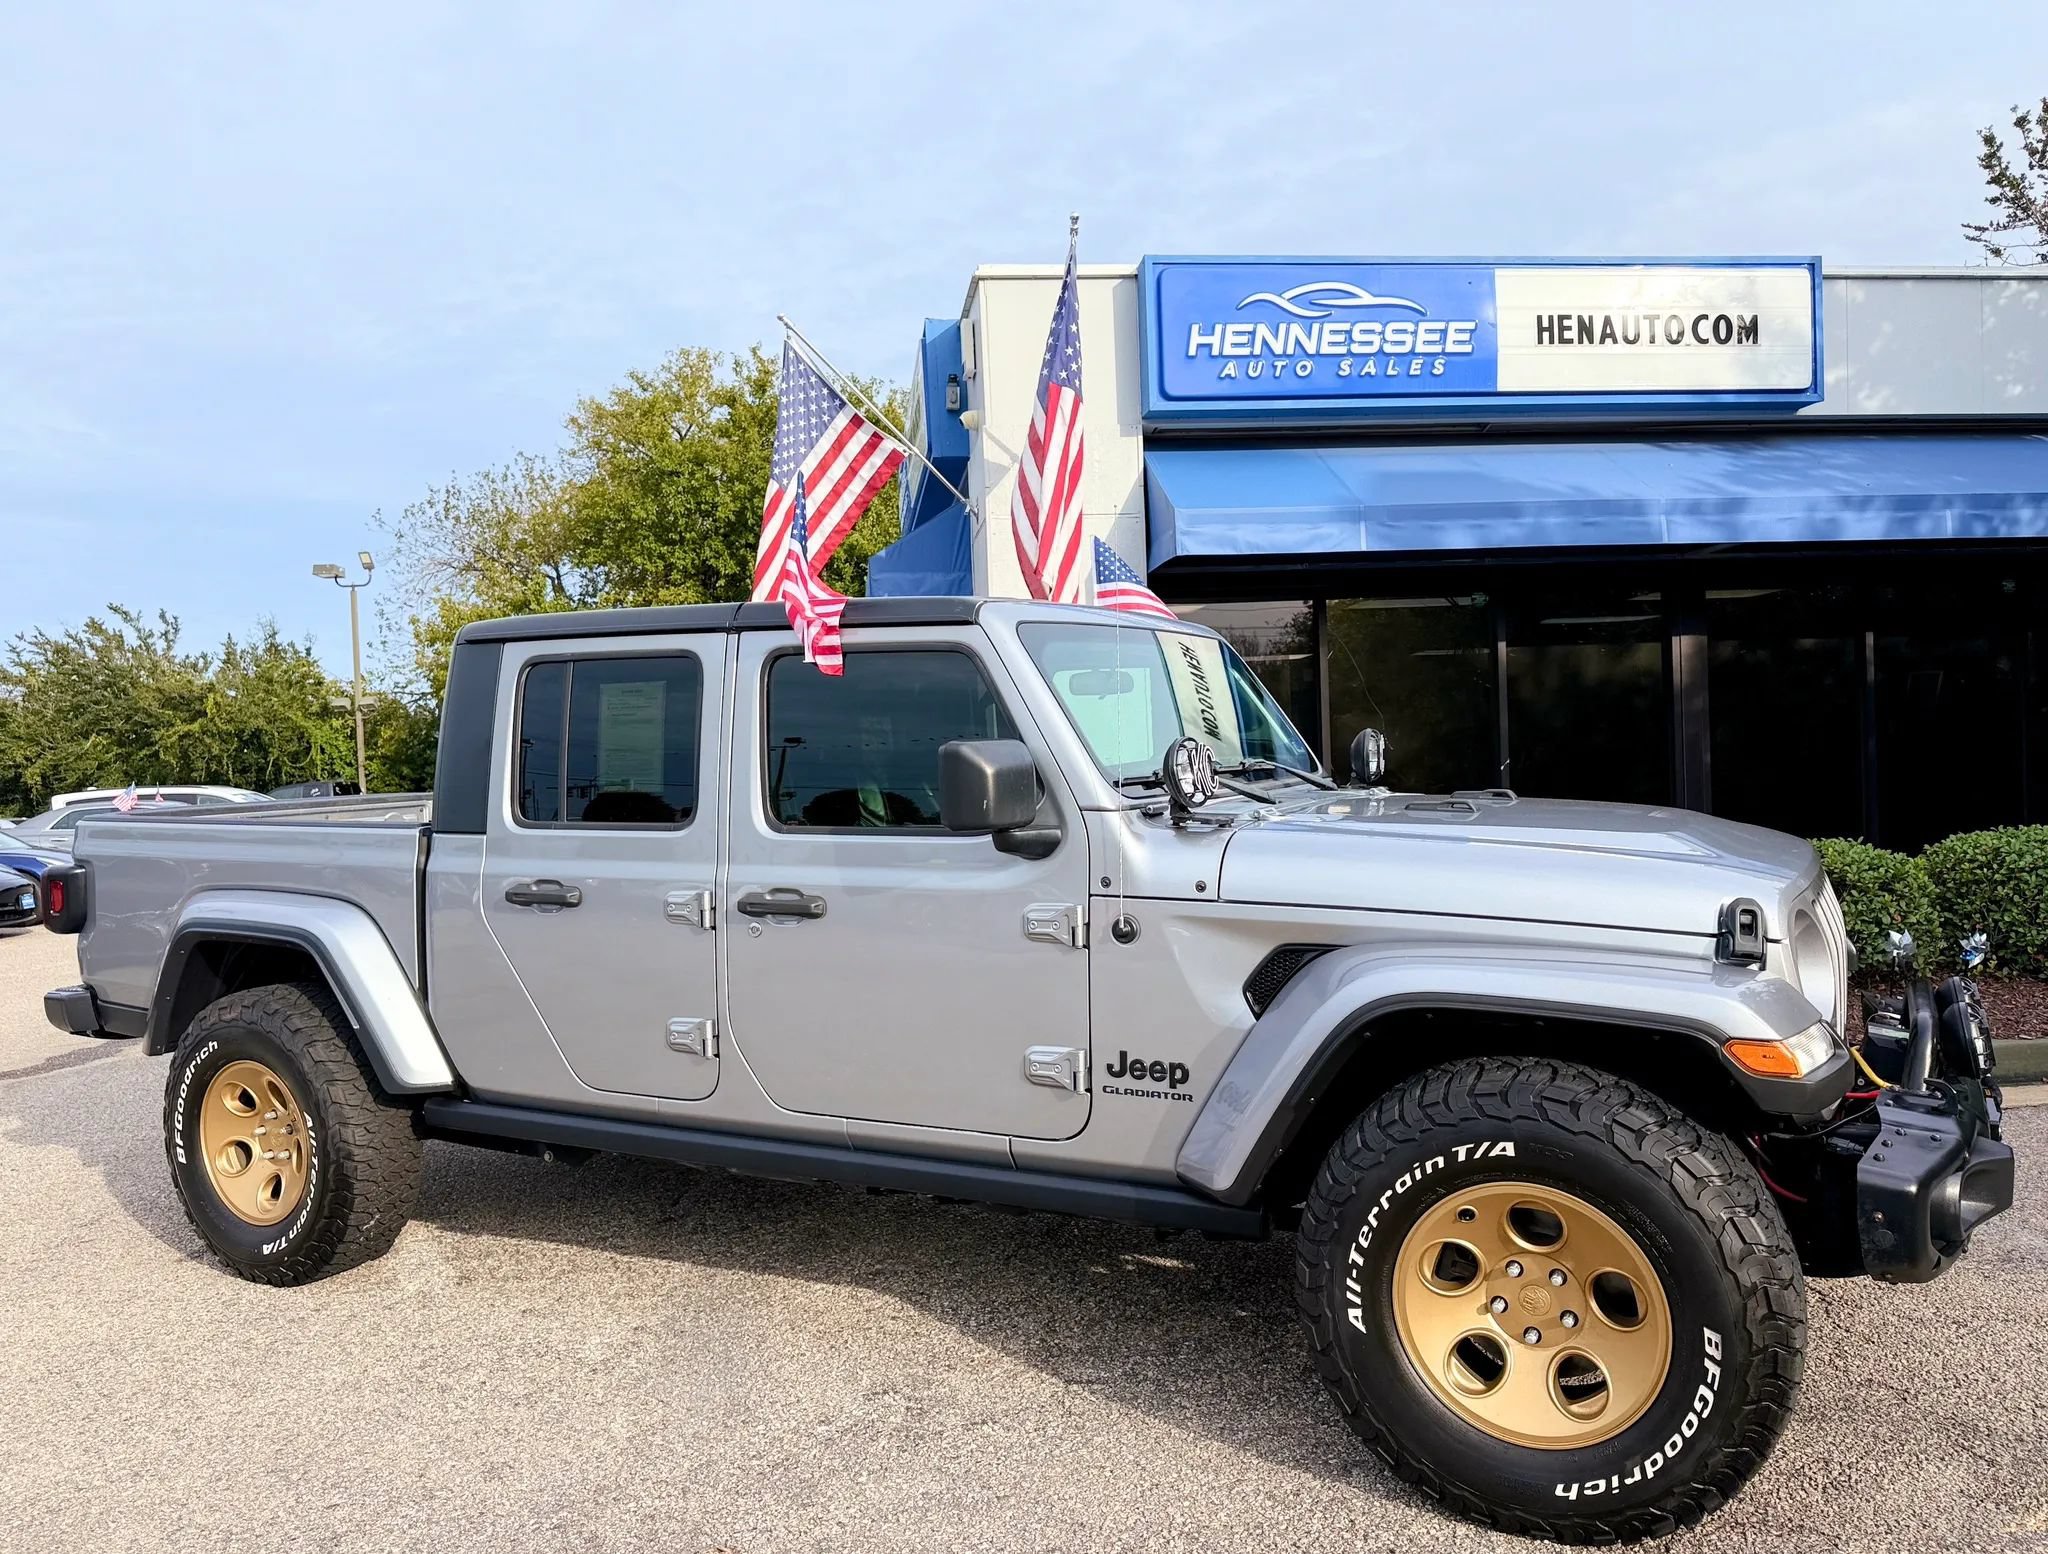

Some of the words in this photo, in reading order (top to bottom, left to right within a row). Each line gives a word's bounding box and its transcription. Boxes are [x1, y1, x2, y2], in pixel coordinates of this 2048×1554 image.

[1187, 320, 1476, 357] HENNESSEE
[1220, 360, 1313, 379] AUTO
[1339, 359, 1446, 377] SALES
[1106, 1050, 1190, 1089] Jeep
[173, 1039, 219, 1165] BFGoodrich
[1102, 1085, 1195, 1102] GLADIATOR
[1345, 1155, 1446, 1335] All-Terrain
[1452, 1141, 1517, 1164] T/A
[1553, 1325, 1724, 1501] BFGoodrich
